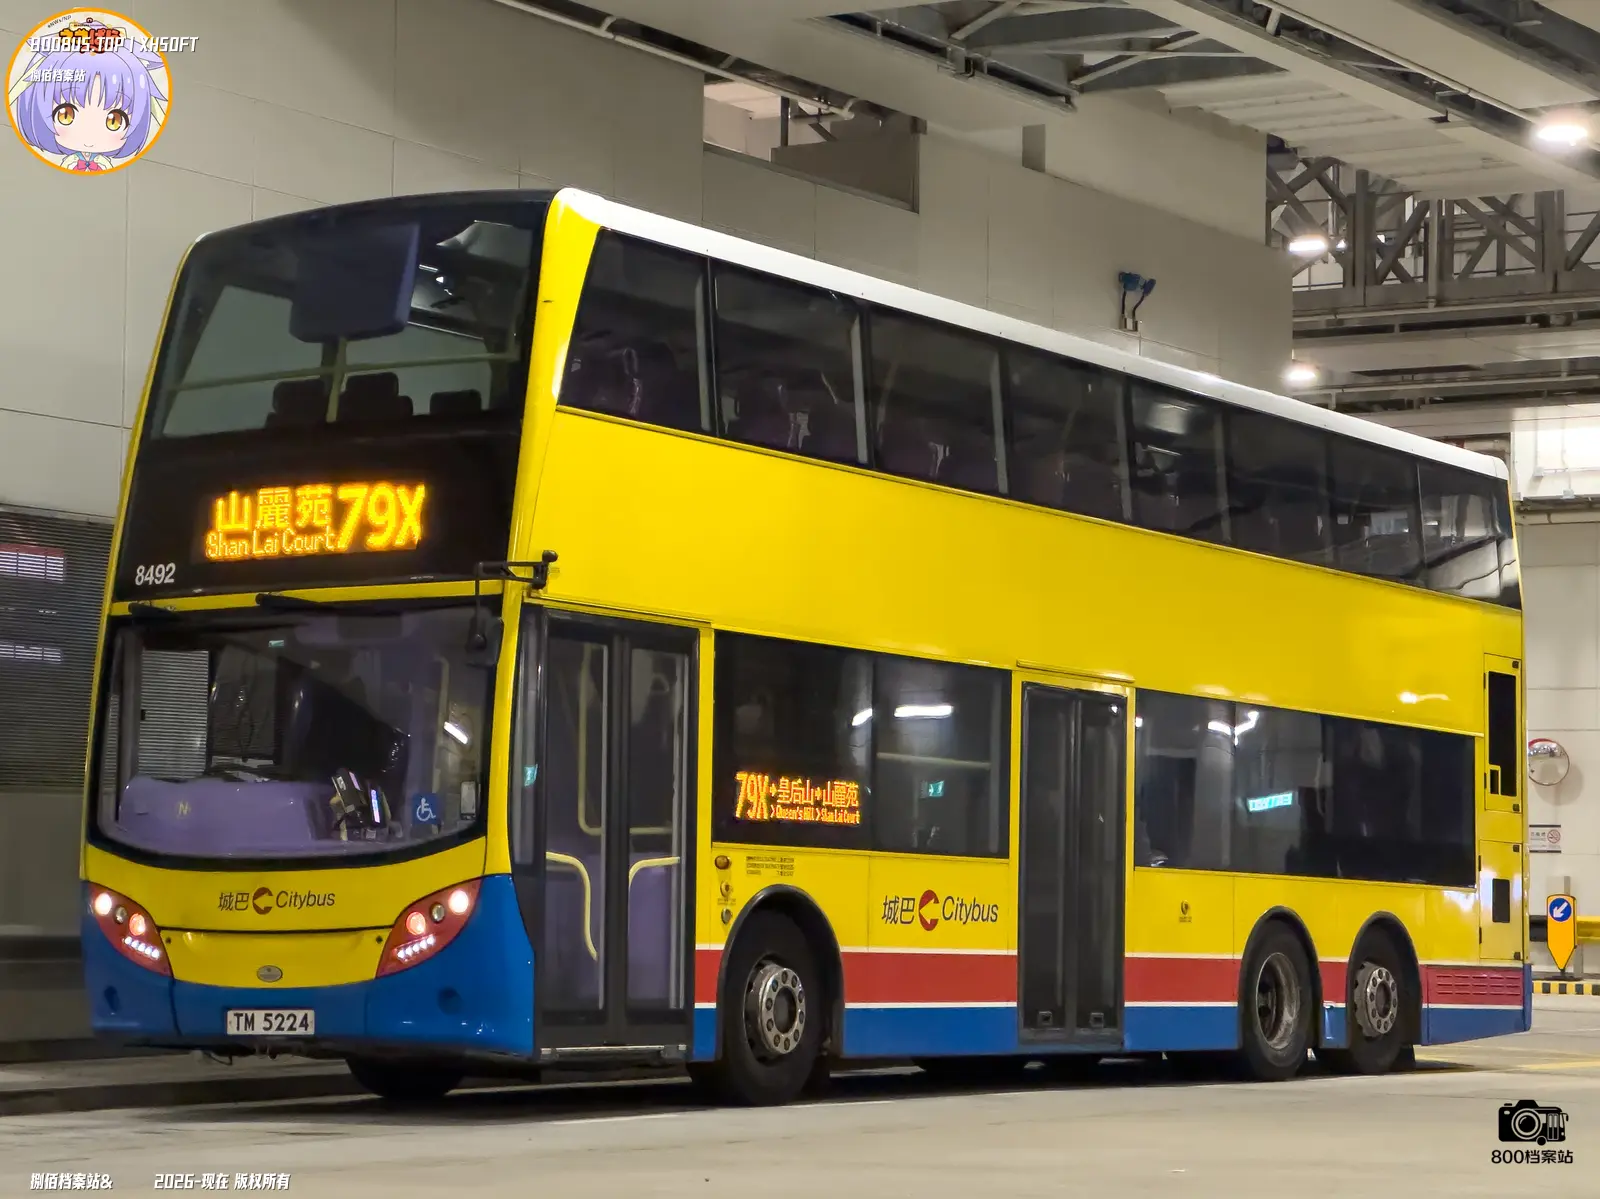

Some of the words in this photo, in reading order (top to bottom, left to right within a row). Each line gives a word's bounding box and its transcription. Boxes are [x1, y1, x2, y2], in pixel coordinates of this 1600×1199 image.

[214, 484, 333, 531] 山麗苑
[336, 481, 426, 551] 79X
[205, 530, 250, 560] Shan
[252, 529, 279, 555] Lai
[281, 525, 336, 553] Court
[135, 562, 176, 586] 8492
[735, 770, 770, 820] 79X
[777, 776, 814, 806] 皇后山
[776, 804, 804, 821] Queen's
[218, 892, 250, 911] 城巴
[276, 890, 336, 909] Citybus
[882, 895, 916, 925] 城巴
[942, 896, 999, 925] Citybus
[233, 1012, 255, 1032] TM
[262, 1012, 310, 1032] 5224
